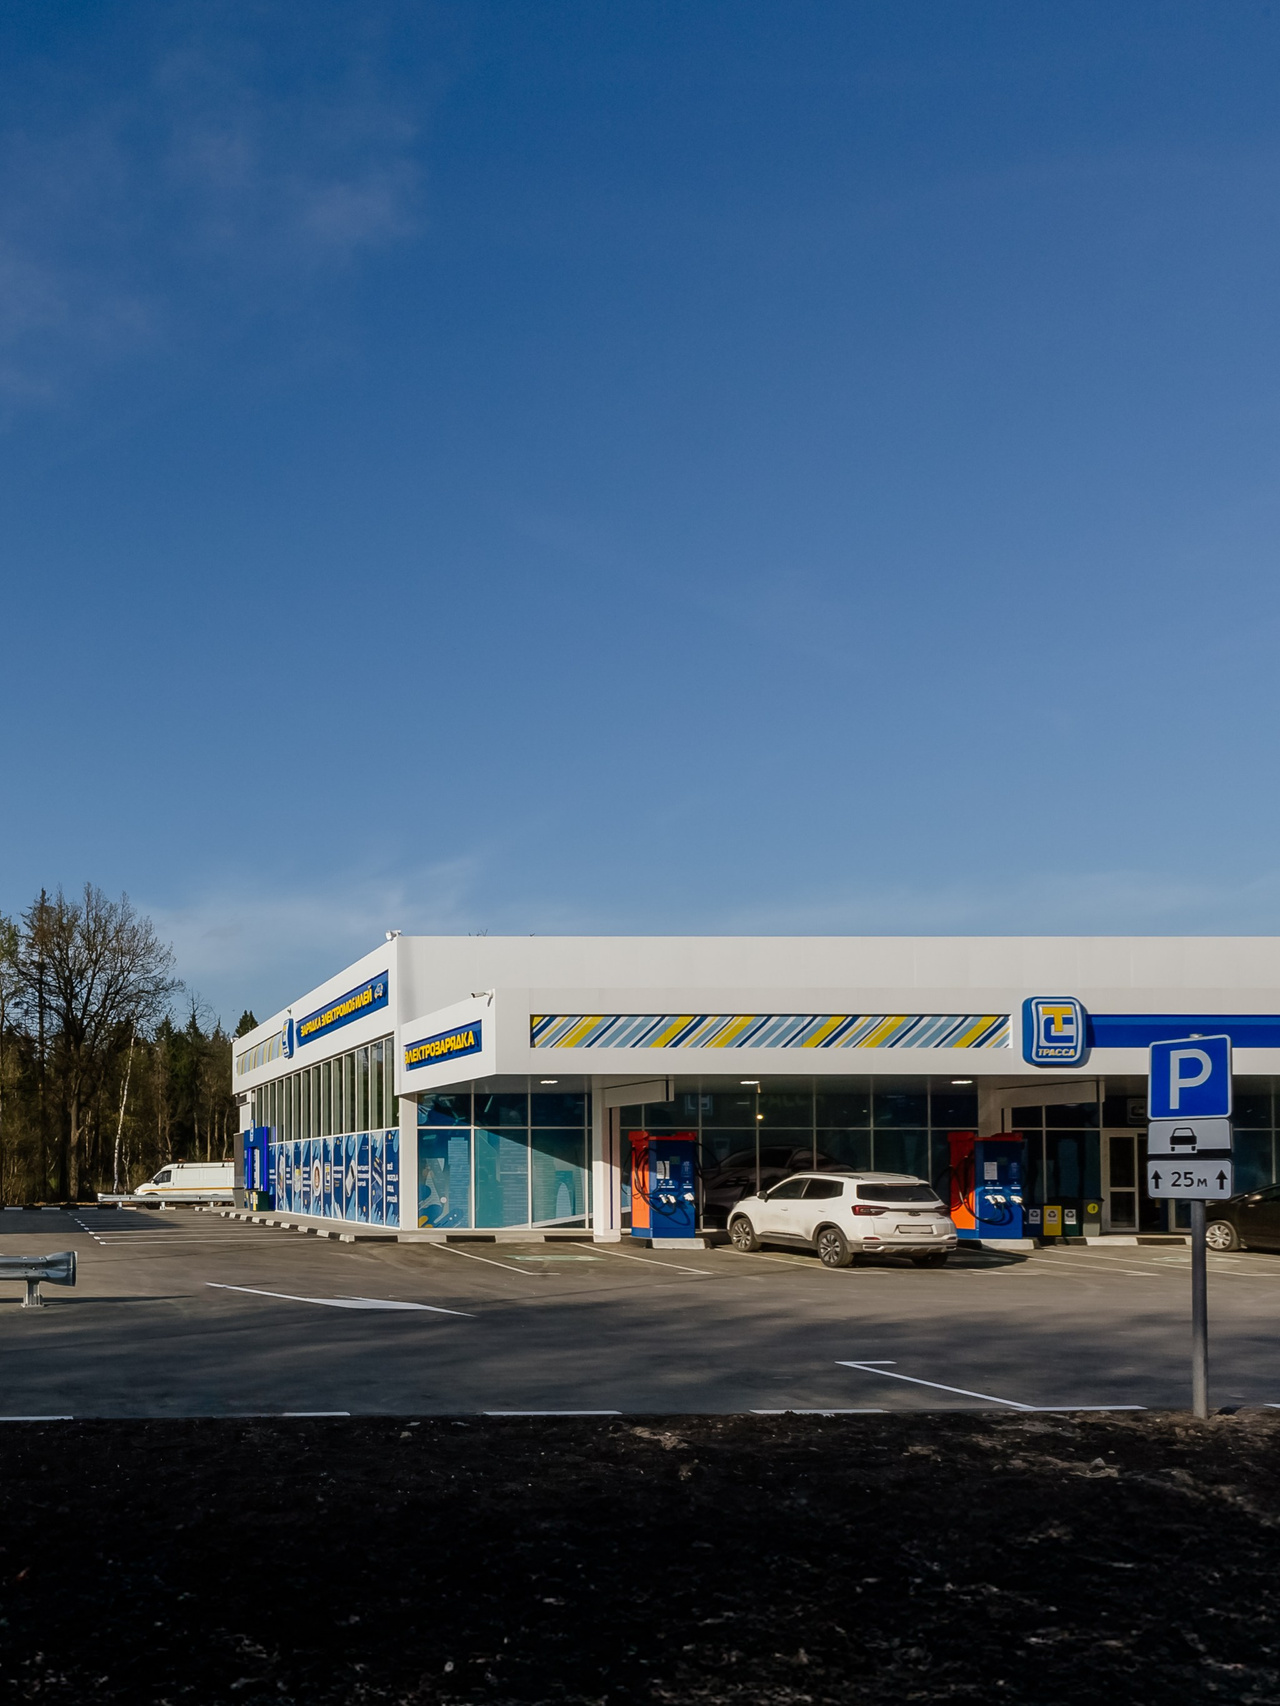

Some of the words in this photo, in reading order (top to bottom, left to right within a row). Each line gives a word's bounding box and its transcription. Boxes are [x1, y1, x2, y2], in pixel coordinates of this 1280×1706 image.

[300, 1016, 321, 1037] ЗАРЯДКА
[321, 985, 372, 1027] ЭЛЕКТРОМОБИЛЕЙ
[405, 1030, 474, 1064] ЭЛЕКТРОЗАРЯДКА
[1038, 1048, 1075, 1056] ТРАССА
[1170, 1049, 1212, 1109] P
